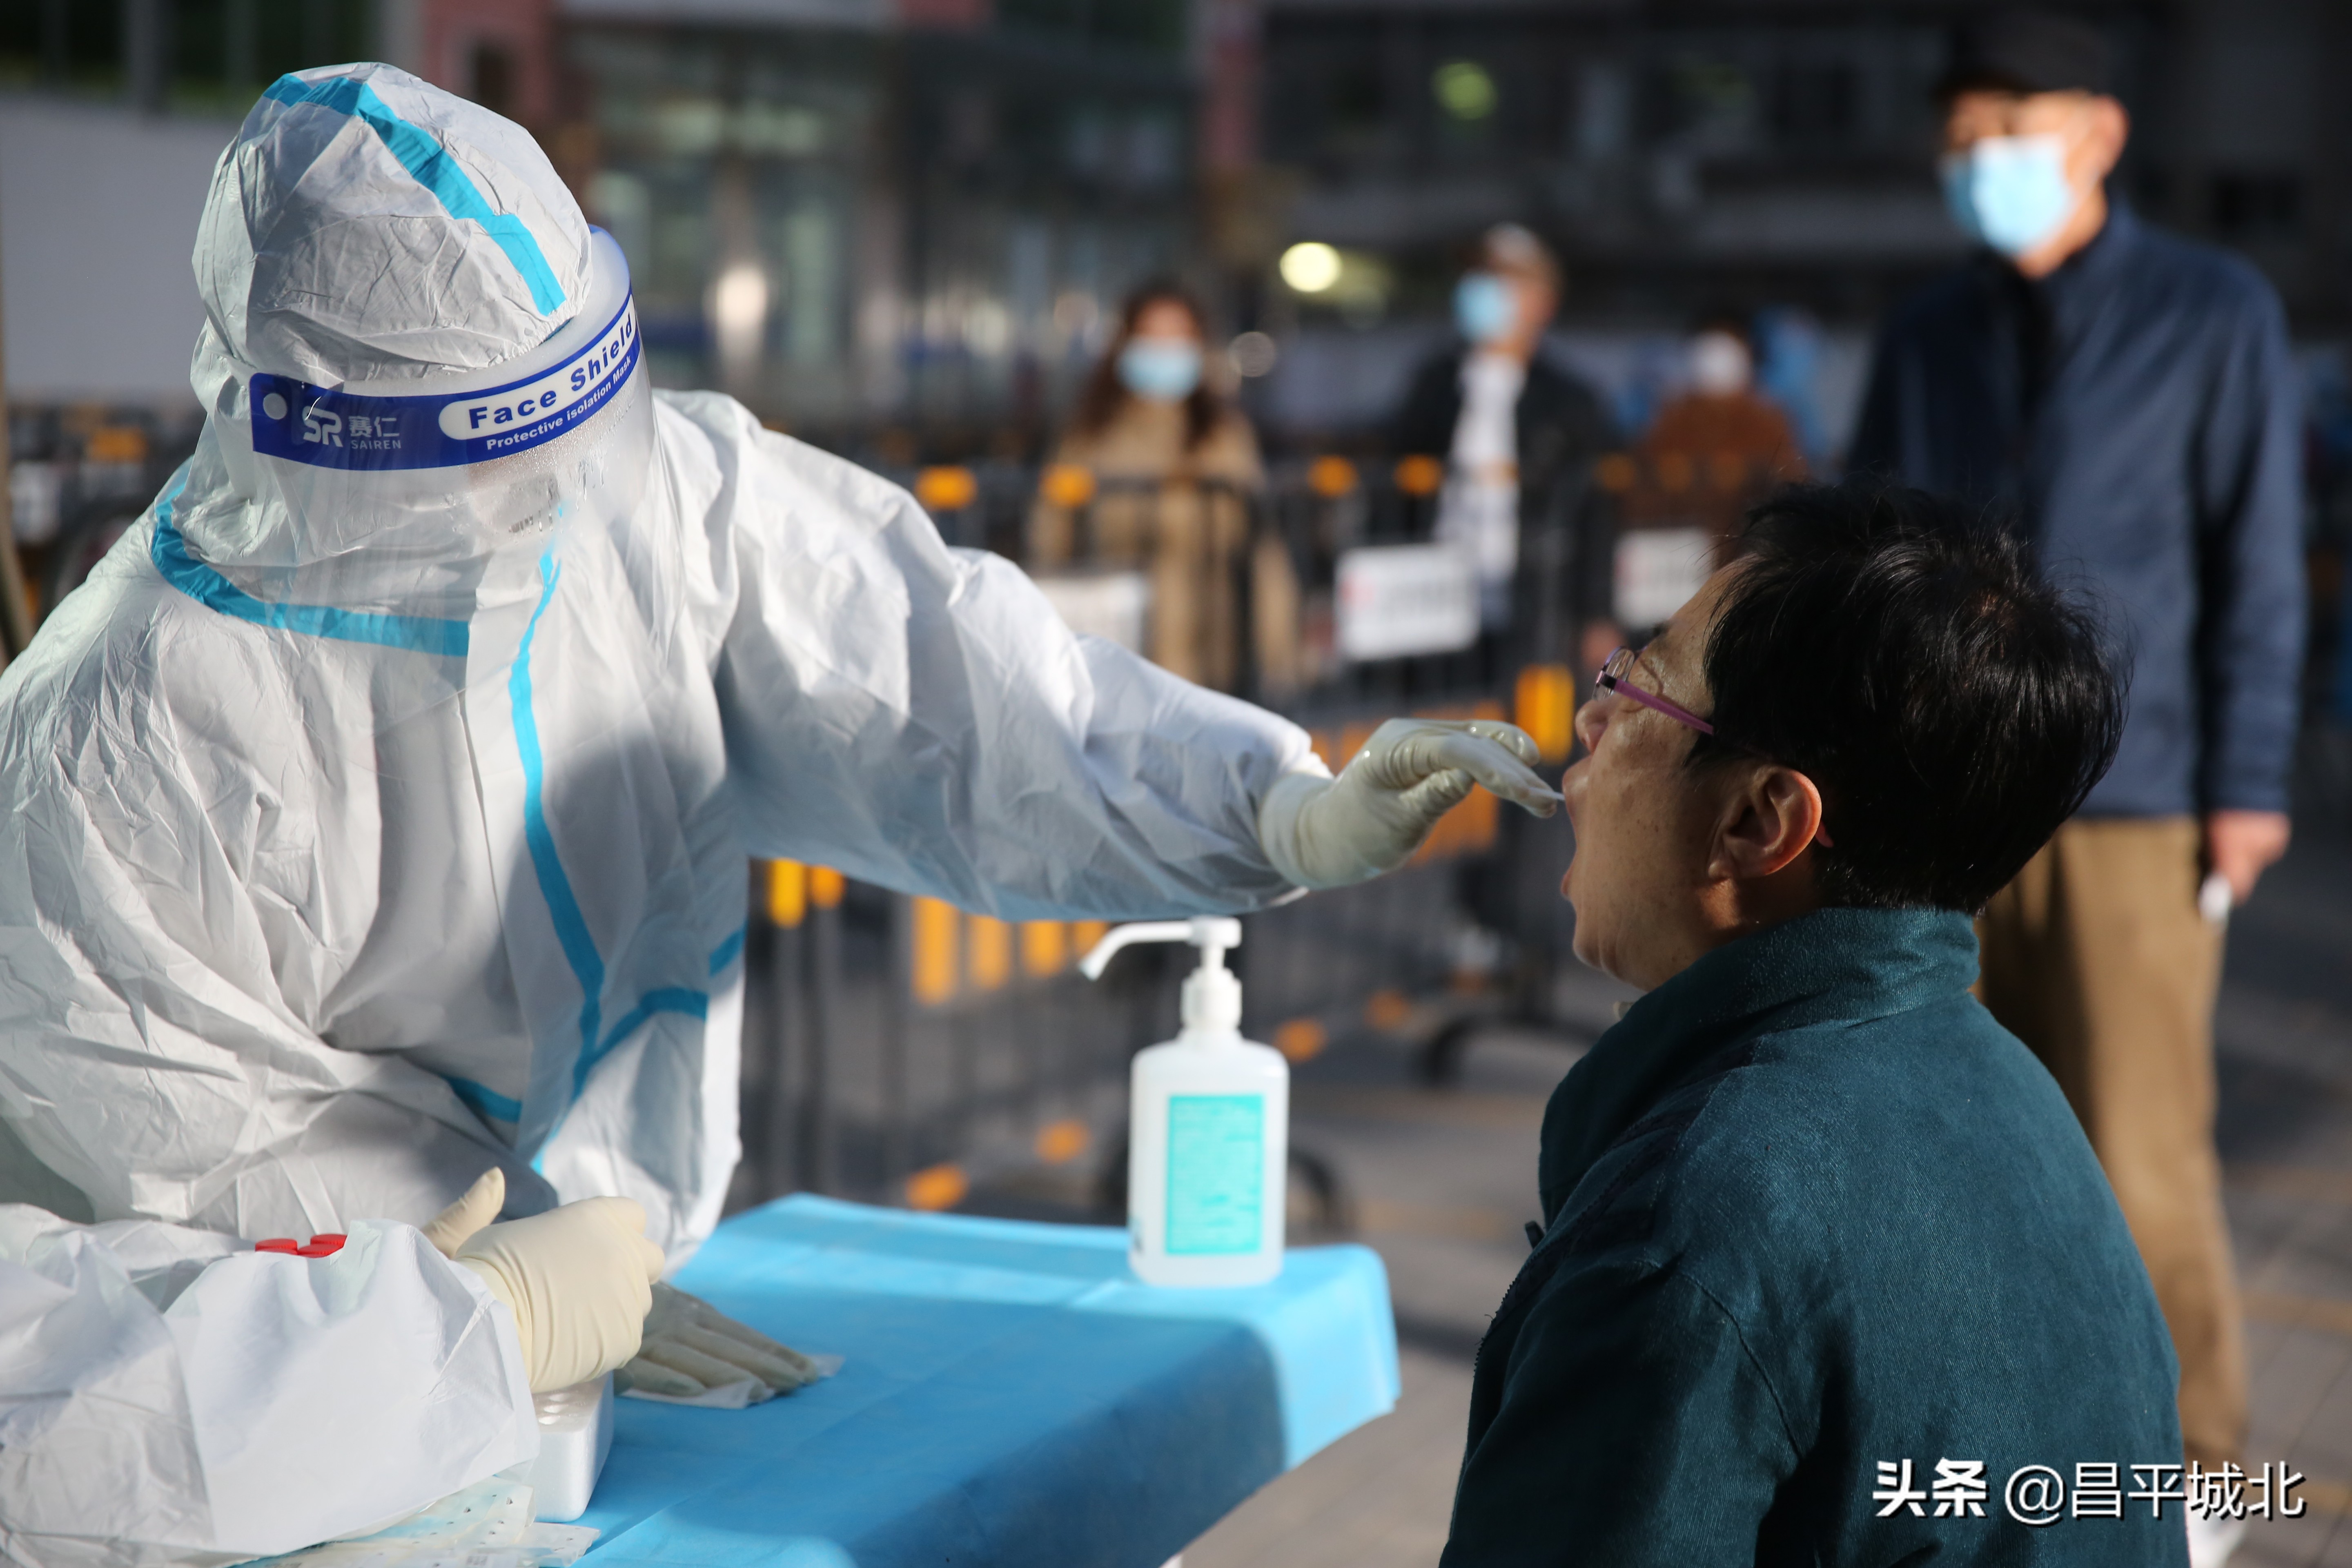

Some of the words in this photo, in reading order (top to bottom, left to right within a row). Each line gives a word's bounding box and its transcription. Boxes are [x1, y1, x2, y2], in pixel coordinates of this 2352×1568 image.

[469, 390, 557, 429] Face
[570, 312, 632, 392] Shield
[348, 415, 400, 437] 赛仁
[486, 416, 564, 450] Protective
[566, 381, 611, 421] isolation
[612, 356, 631, 385] Mask
[351, 440, 401, 449] SAIREN
